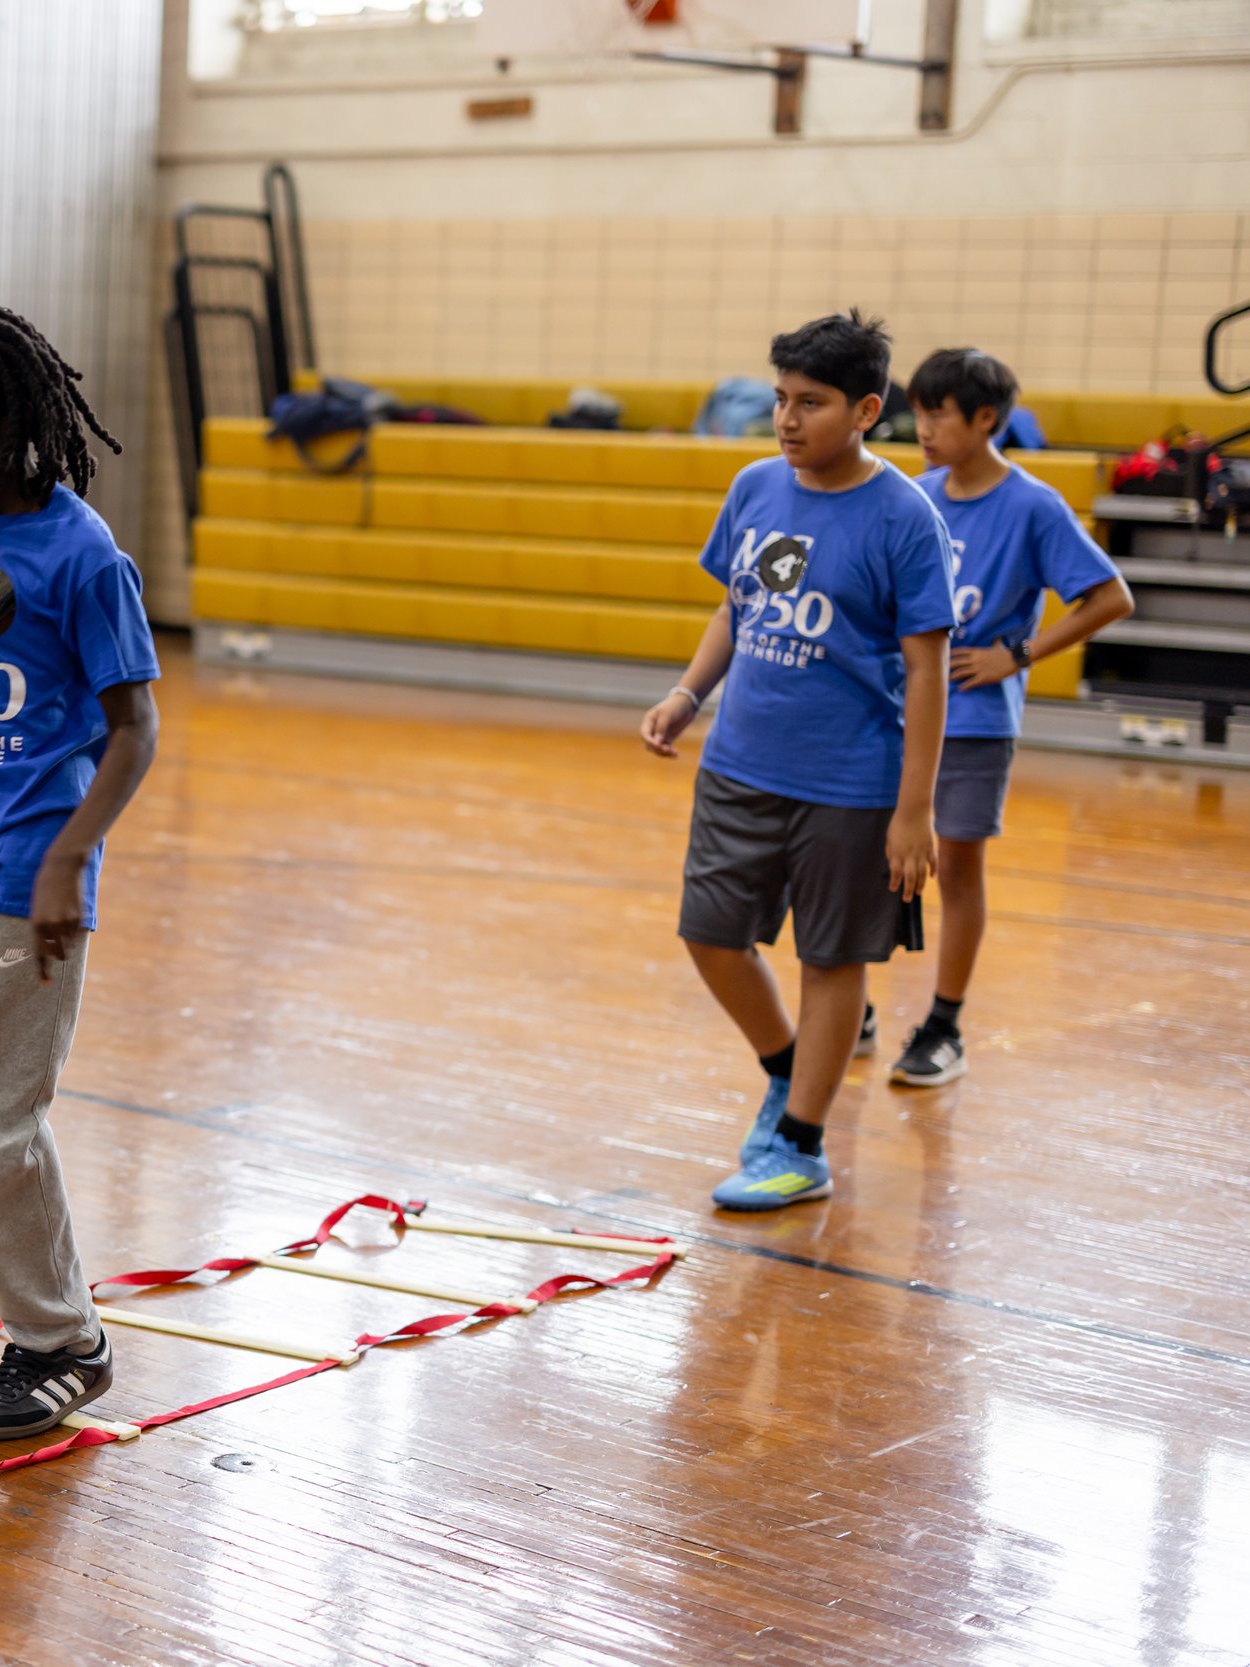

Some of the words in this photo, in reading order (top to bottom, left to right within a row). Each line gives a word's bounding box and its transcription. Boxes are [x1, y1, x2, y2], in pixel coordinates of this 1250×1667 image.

[763, 587, 833, 638] 50
[953, 585, 982, 623] 0
[3, 948, 27, 960] NIKE
